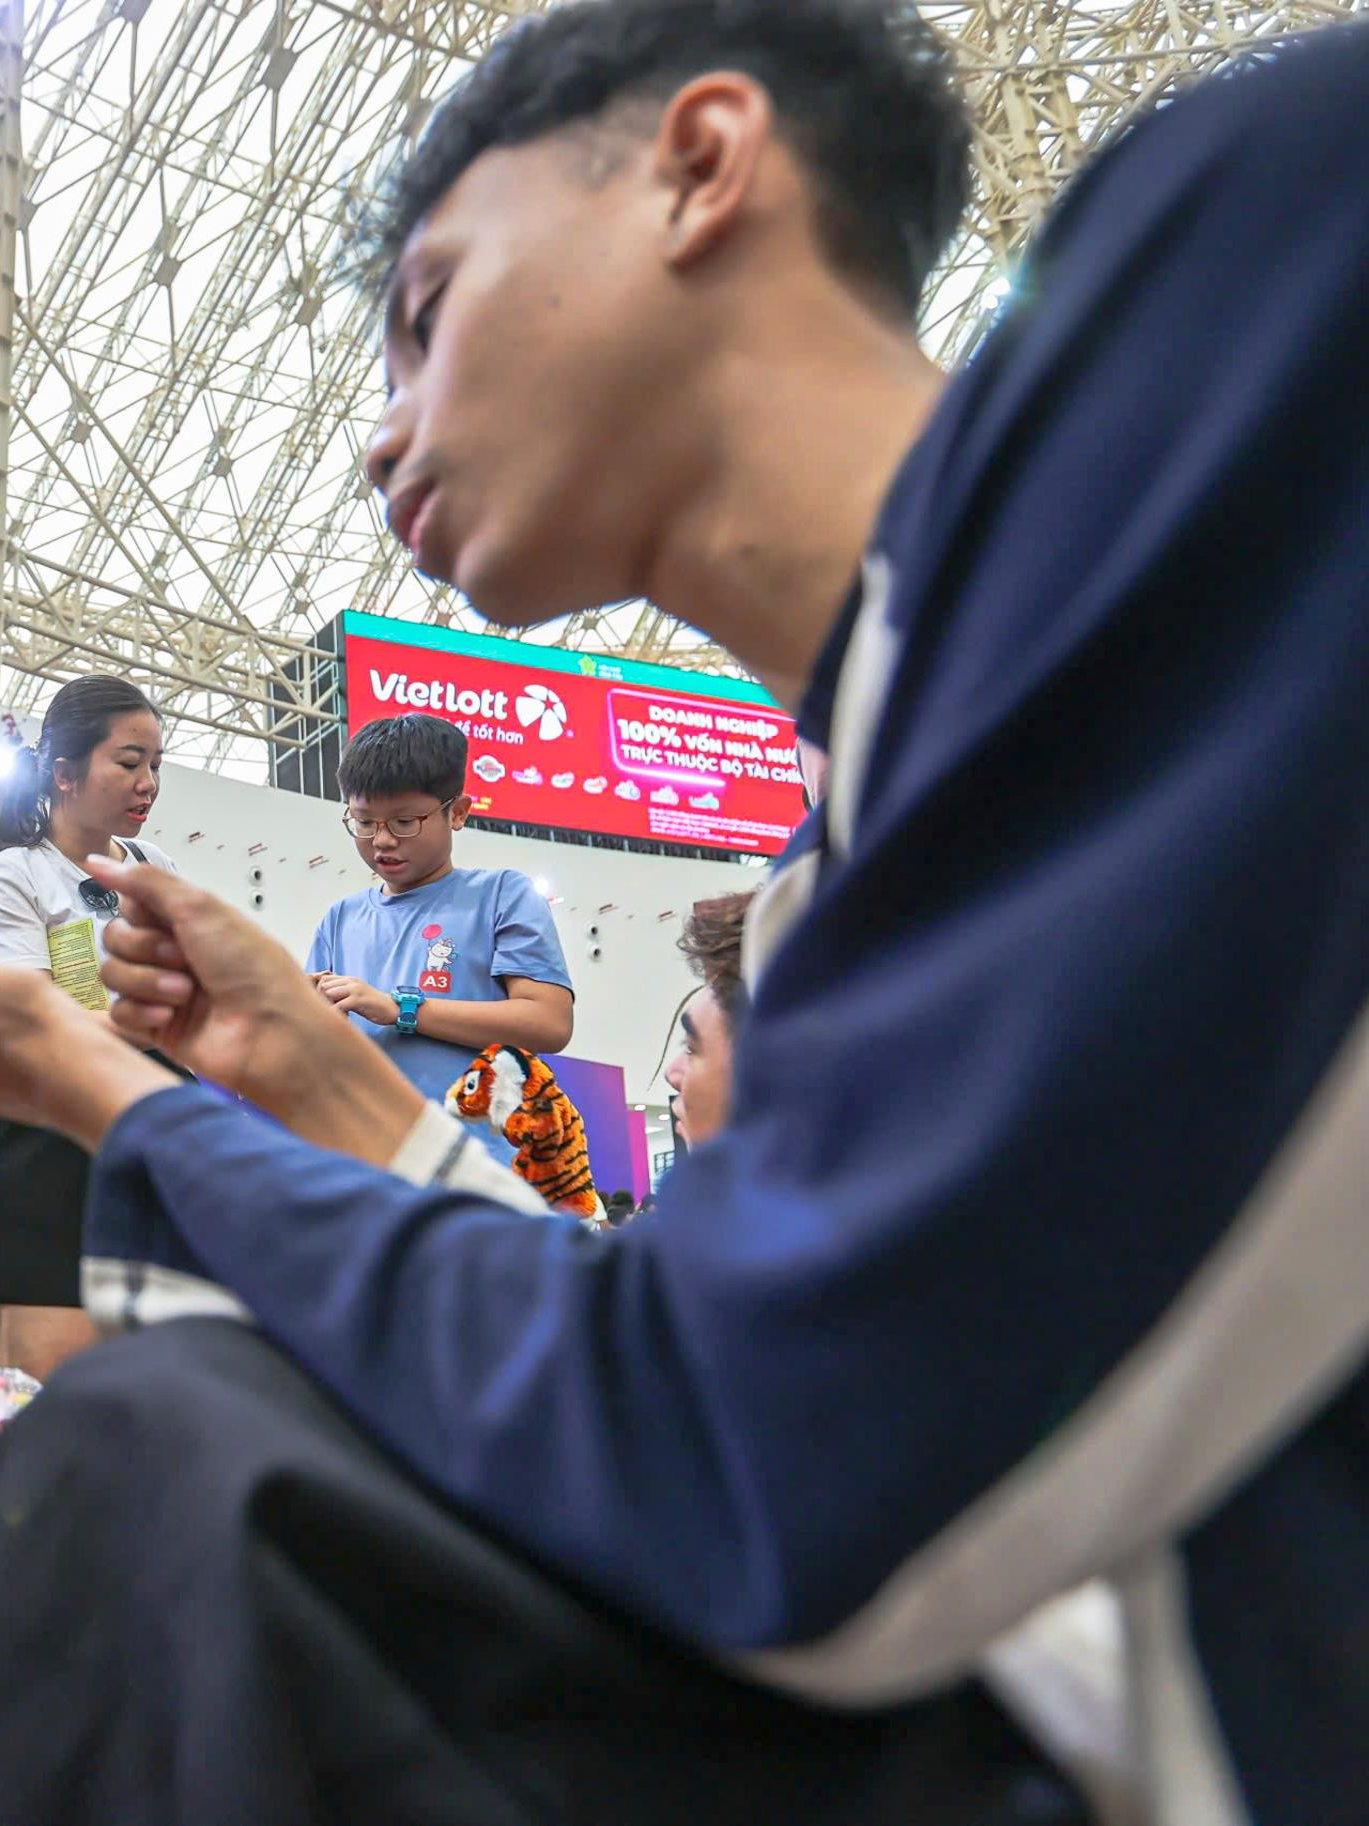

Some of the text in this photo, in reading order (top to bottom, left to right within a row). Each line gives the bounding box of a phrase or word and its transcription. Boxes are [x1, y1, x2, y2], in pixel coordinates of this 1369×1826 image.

[370, 669, 509, 720] Vietlott
[473, 723, 494, 741] tốt
[496, 726, 524, 745] hơn
[617, 718, 682, 748] 100%
[684, 733, 723, 754] VỐN
[725, 740, 764, 761] NHÀ
[649, 705, 779, 741] DOANH NGHIỆP
[621, 744, 663, 765] TRỰC
[664, 750, 719, 773] THUỘC
[720, 758, 743, 779] BỘ
[744, 761, 770, 780] TÀI
[423, 975, 448, 988] A3
